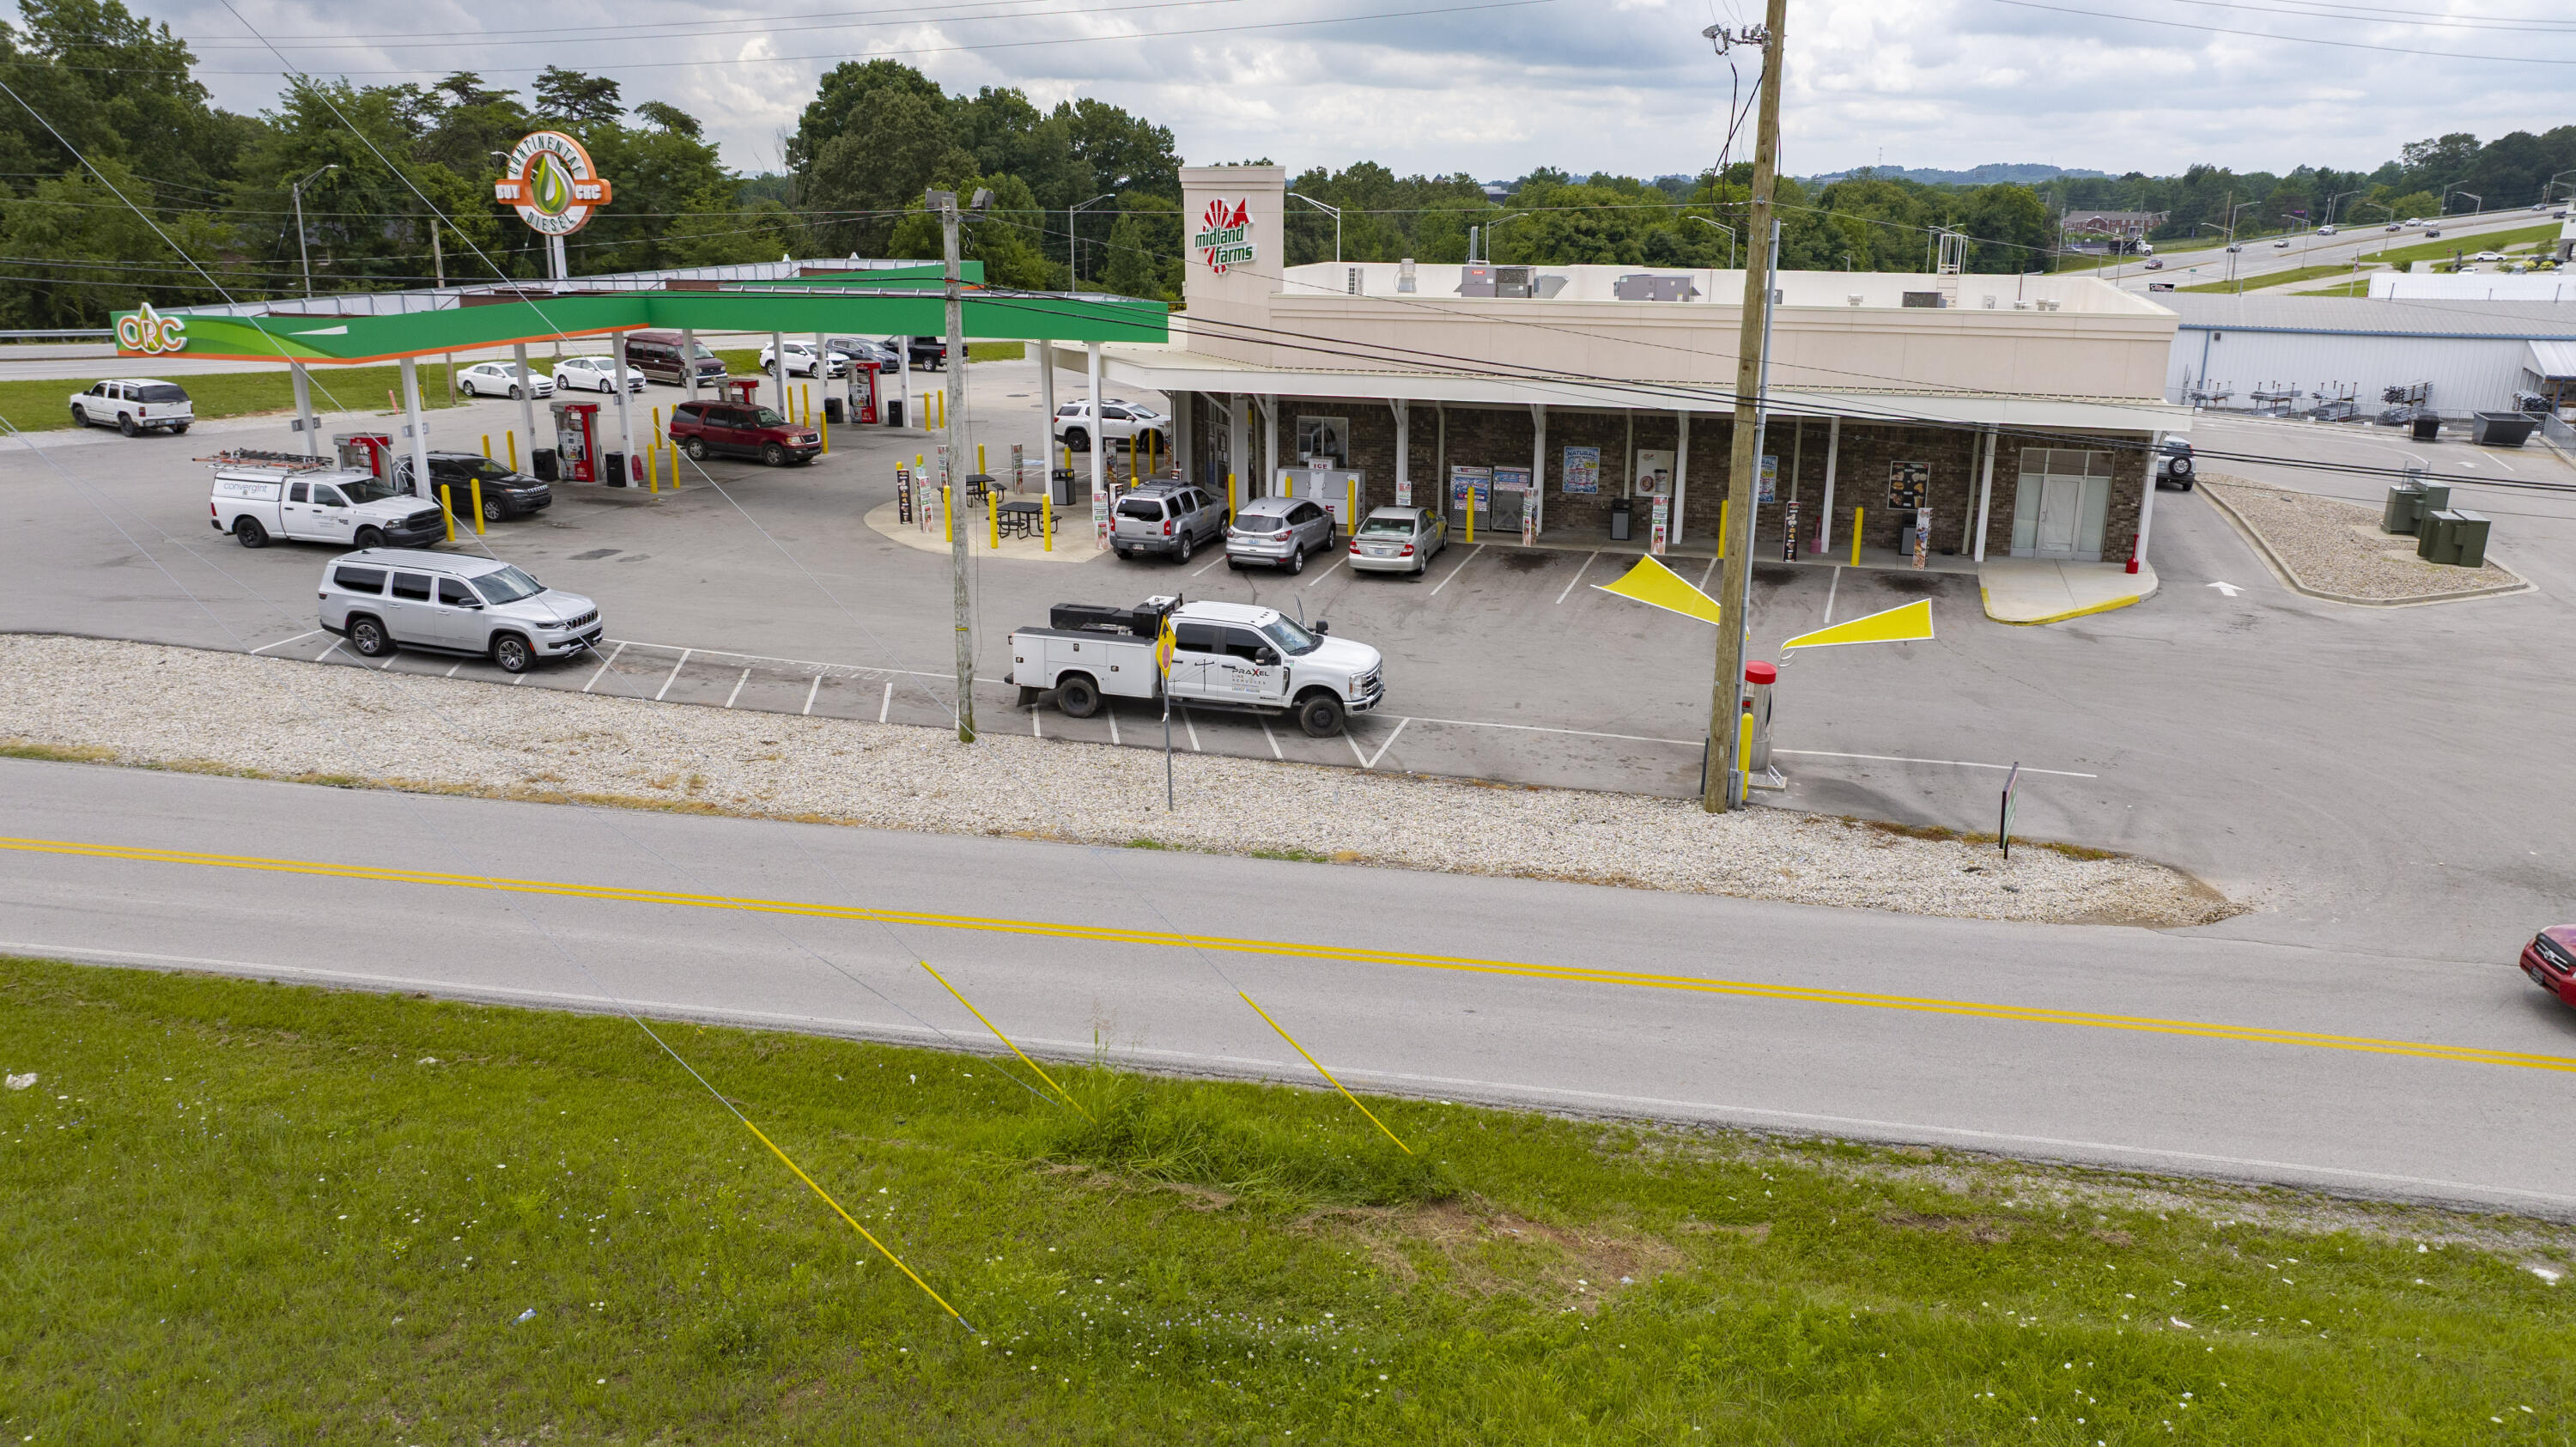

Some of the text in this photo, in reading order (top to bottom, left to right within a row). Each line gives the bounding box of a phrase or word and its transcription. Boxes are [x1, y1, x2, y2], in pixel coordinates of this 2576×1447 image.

[508, 135, 581, 175] CONTINENTAL
[495, 184, 602, 200] BUY CRC
[526, 211, 574, 232] DIESEL
[1194, 223, 1244, 248] midland
[1215, 246, 1253, 264] farms
[223, 481, 268, 494] convergint
[1232, 668, 1270, 678] PRAXEL
